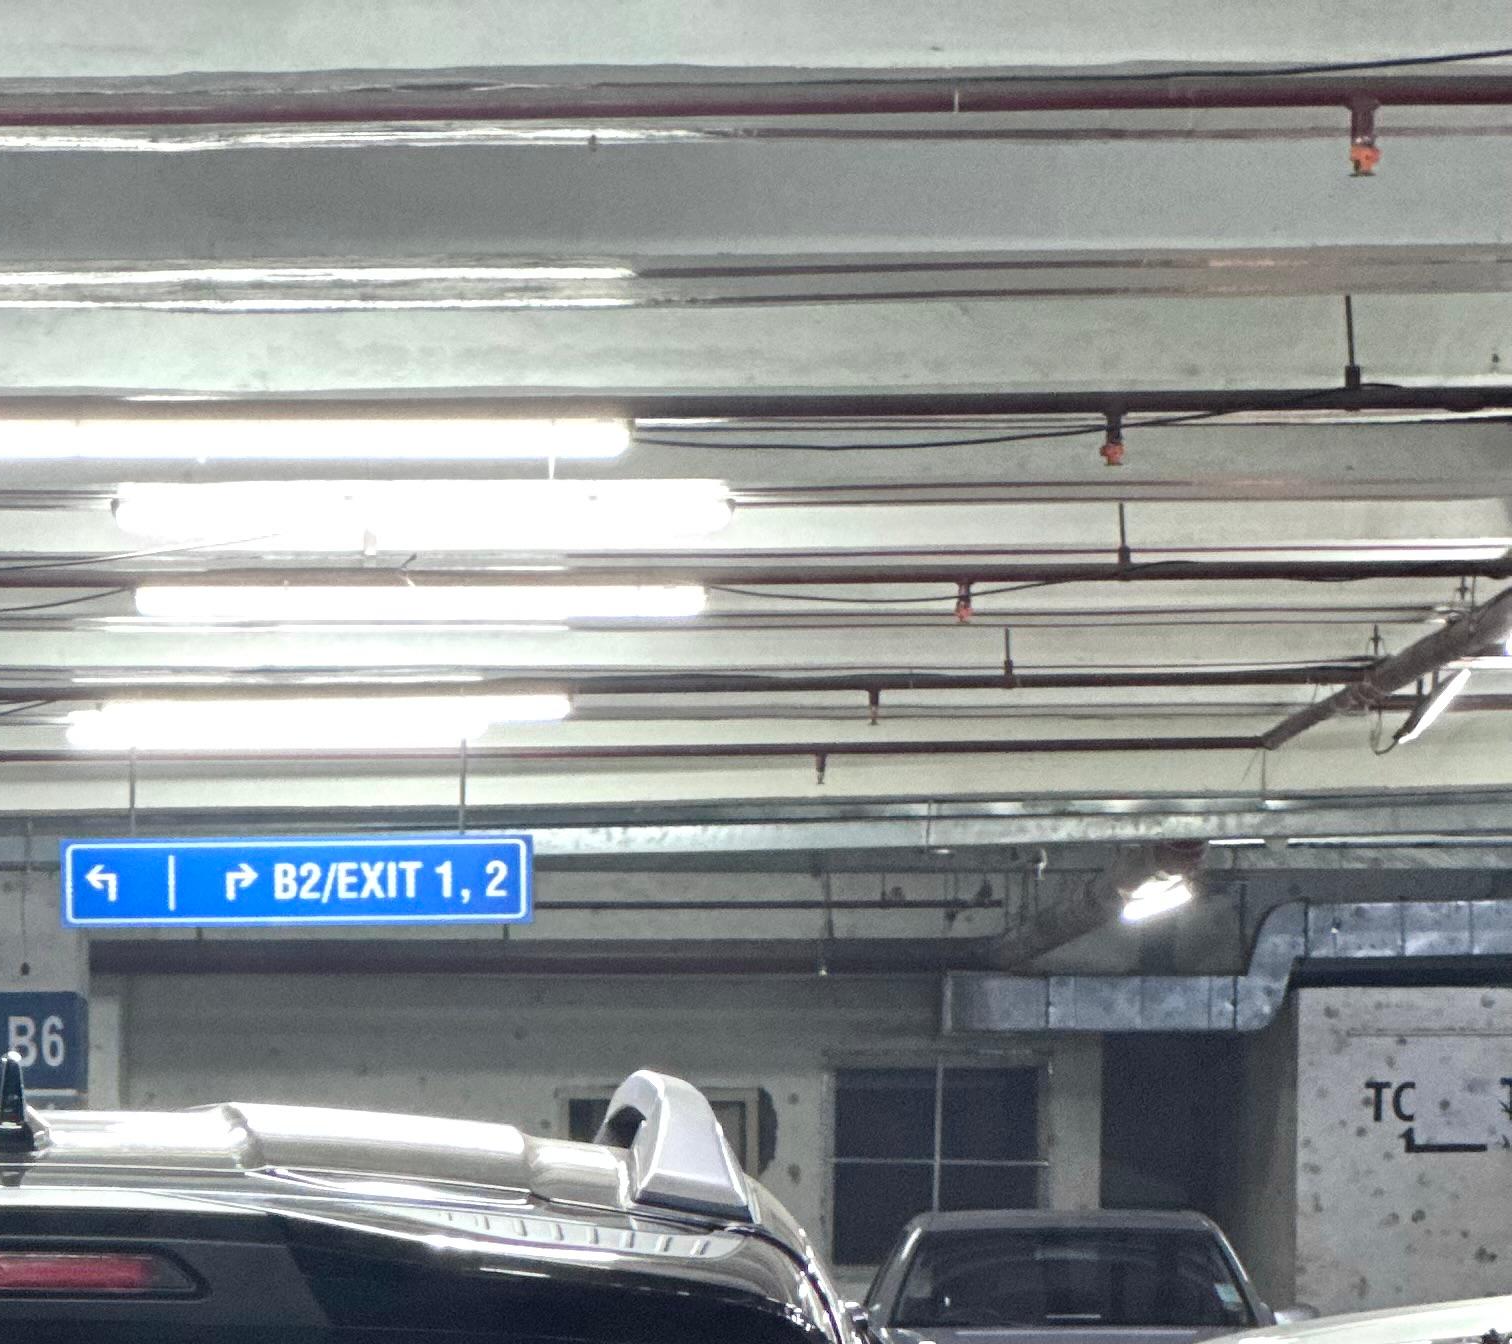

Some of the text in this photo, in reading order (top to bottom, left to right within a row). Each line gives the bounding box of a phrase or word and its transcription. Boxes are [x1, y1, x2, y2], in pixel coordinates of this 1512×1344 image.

[274, 860, 508, 905] B2/EXIT 1, 2
[8, 1015, 65, 1067] B6
